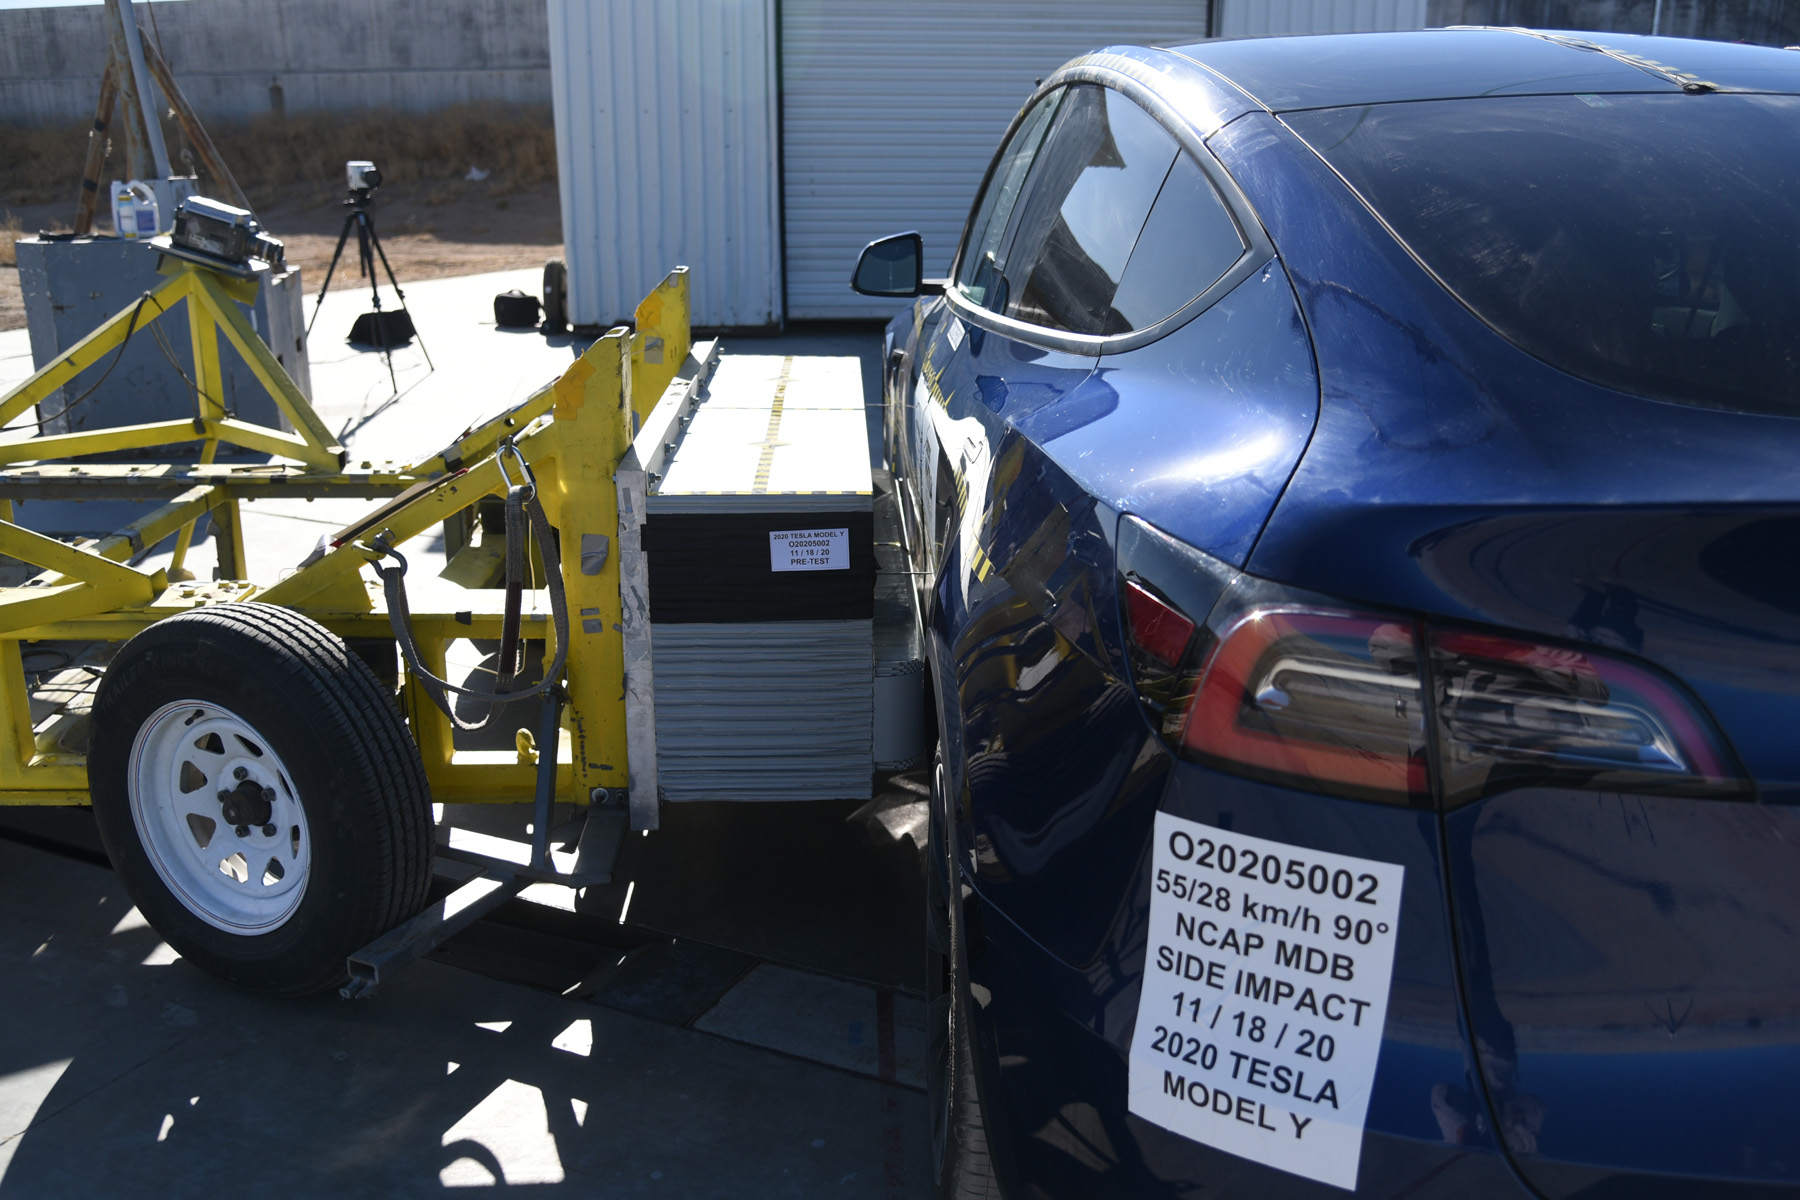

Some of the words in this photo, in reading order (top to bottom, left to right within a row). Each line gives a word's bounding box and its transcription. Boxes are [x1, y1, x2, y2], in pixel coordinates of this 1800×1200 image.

[788, 540, 830, 548] O20205002
[790, 557, 830, 565] PRE-TEST
[1168, 830, 1379, 905] O20205002
[1156, 868, 1231, 912] 55/28
[1242, 893, 1321, 935] km/h
[1333, 914, 1389, 945] 90°
[1175, 911, 1265, 957] NCAP
[1275, 939, 1355, 982] MDB
[1156, 945, 1226, 990] SIDE
[1234, 970, 1371, 1027] IMPACT
[1172, 991, 1202, 1023] 11
[1232, 1011, 1267, 1043] 18
[1294, 1028, 1335, 1062] 20
[1151, 1025, 1218, 1070] 2020
[1229, 1050, 1340, 1110] TESLA
[1163, 1070, 1277, 1132] MODEL
[1289, 1112, 1313, 1140] Y
